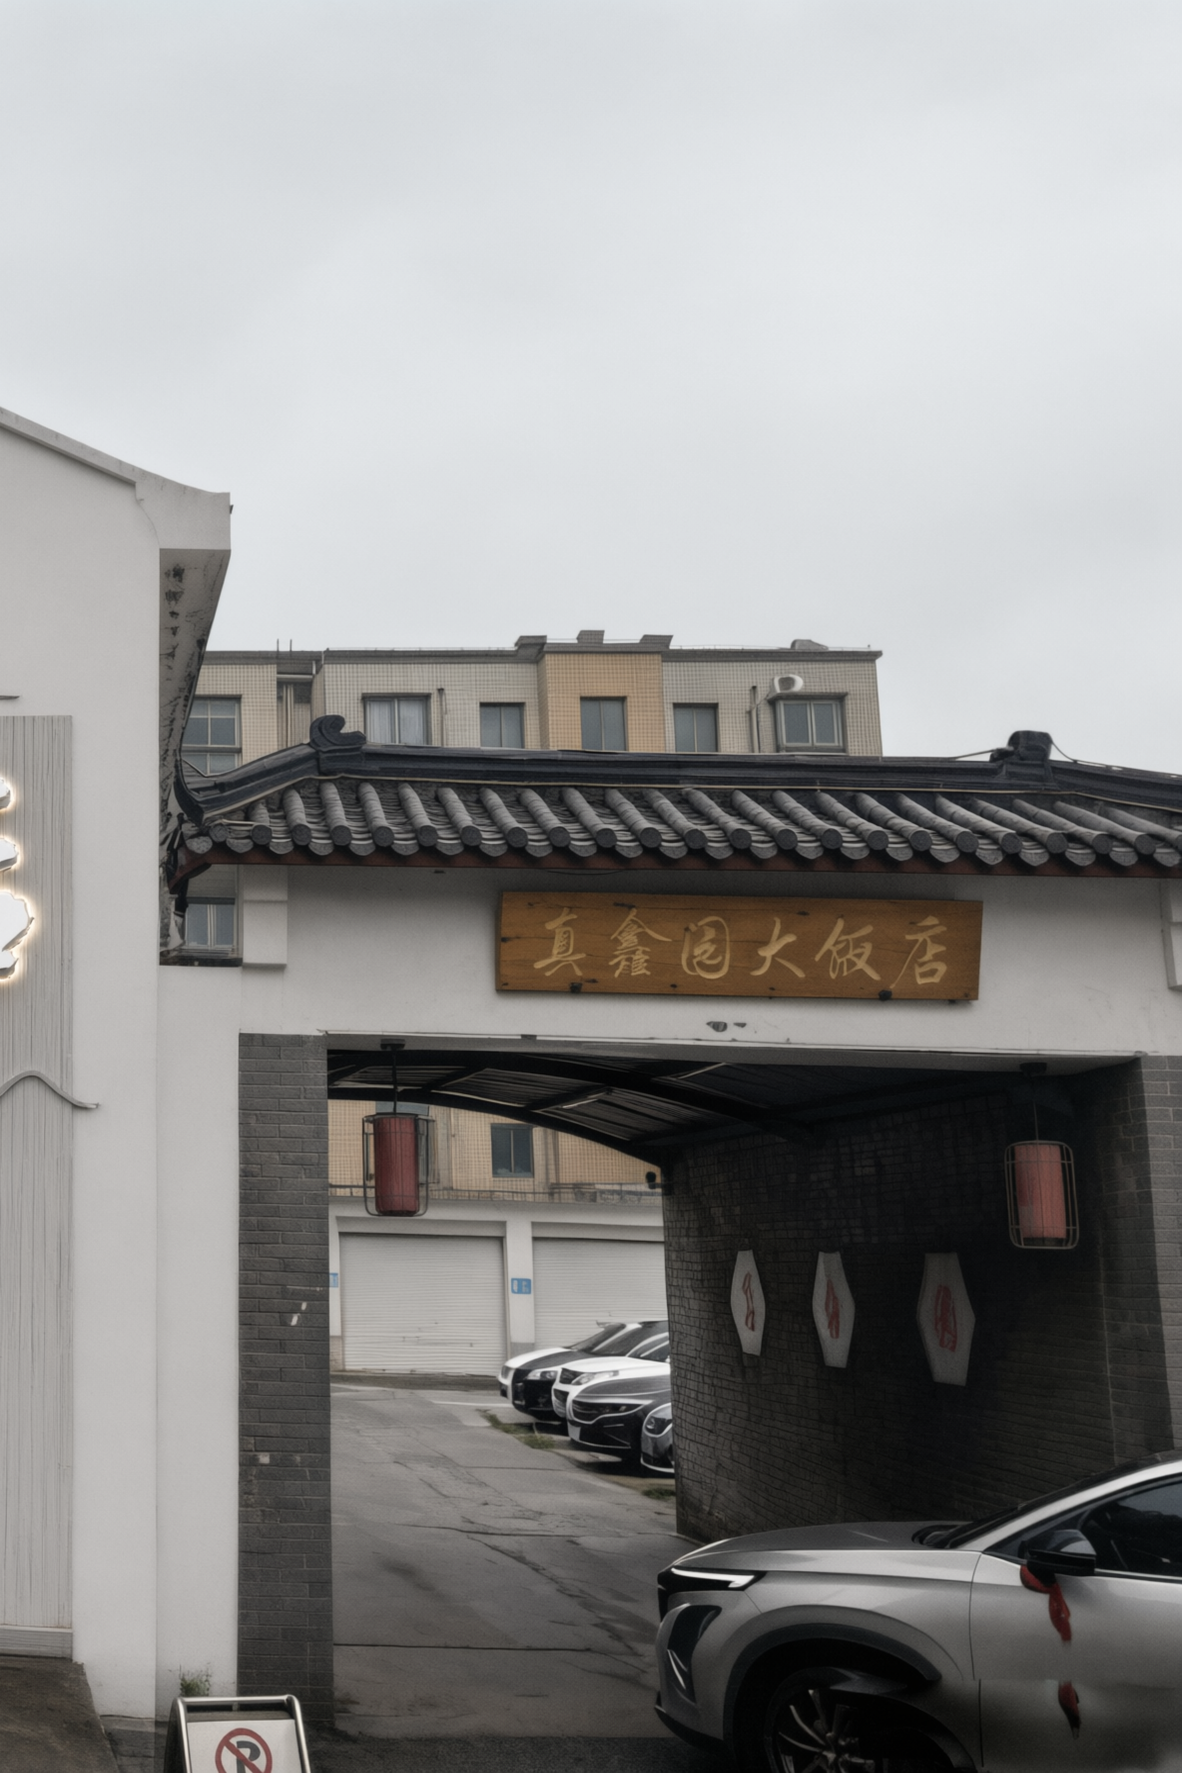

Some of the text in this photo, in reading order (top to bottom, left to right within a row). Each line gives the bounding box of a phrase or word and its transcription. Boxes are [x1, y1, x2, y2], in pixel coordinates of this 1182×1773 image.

[533, 907, 948, 989] 真鑫园大饭店
